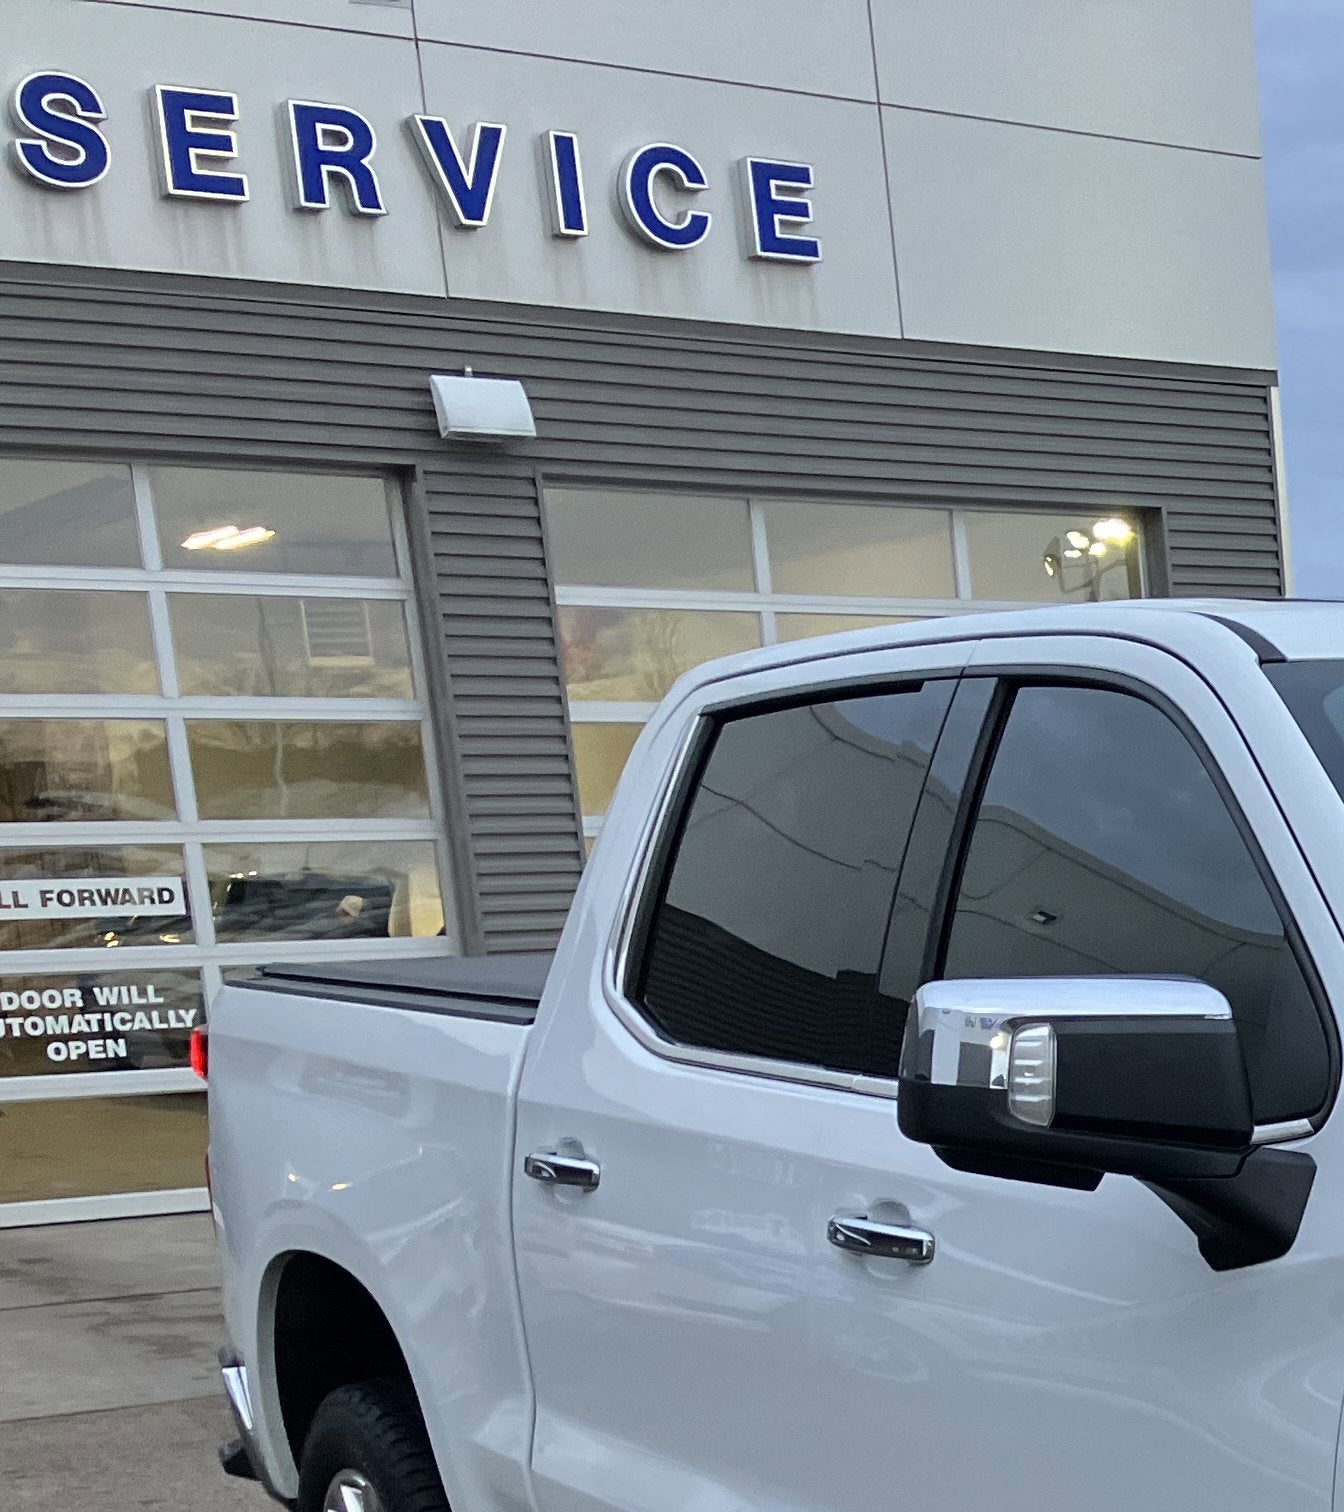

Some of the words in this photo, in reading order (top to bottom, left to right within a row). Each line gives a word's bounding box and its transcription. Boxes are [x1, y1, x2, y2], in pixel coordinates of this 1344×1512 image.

[11, 70, 822, 264] SERVICE
[39, 887, 175, 908] FORWARD
[0, 988, 84, 1010] DOOR
[92, 985, 164, 1006] WILL
[47, 1039, 127, 1062] OPEN
